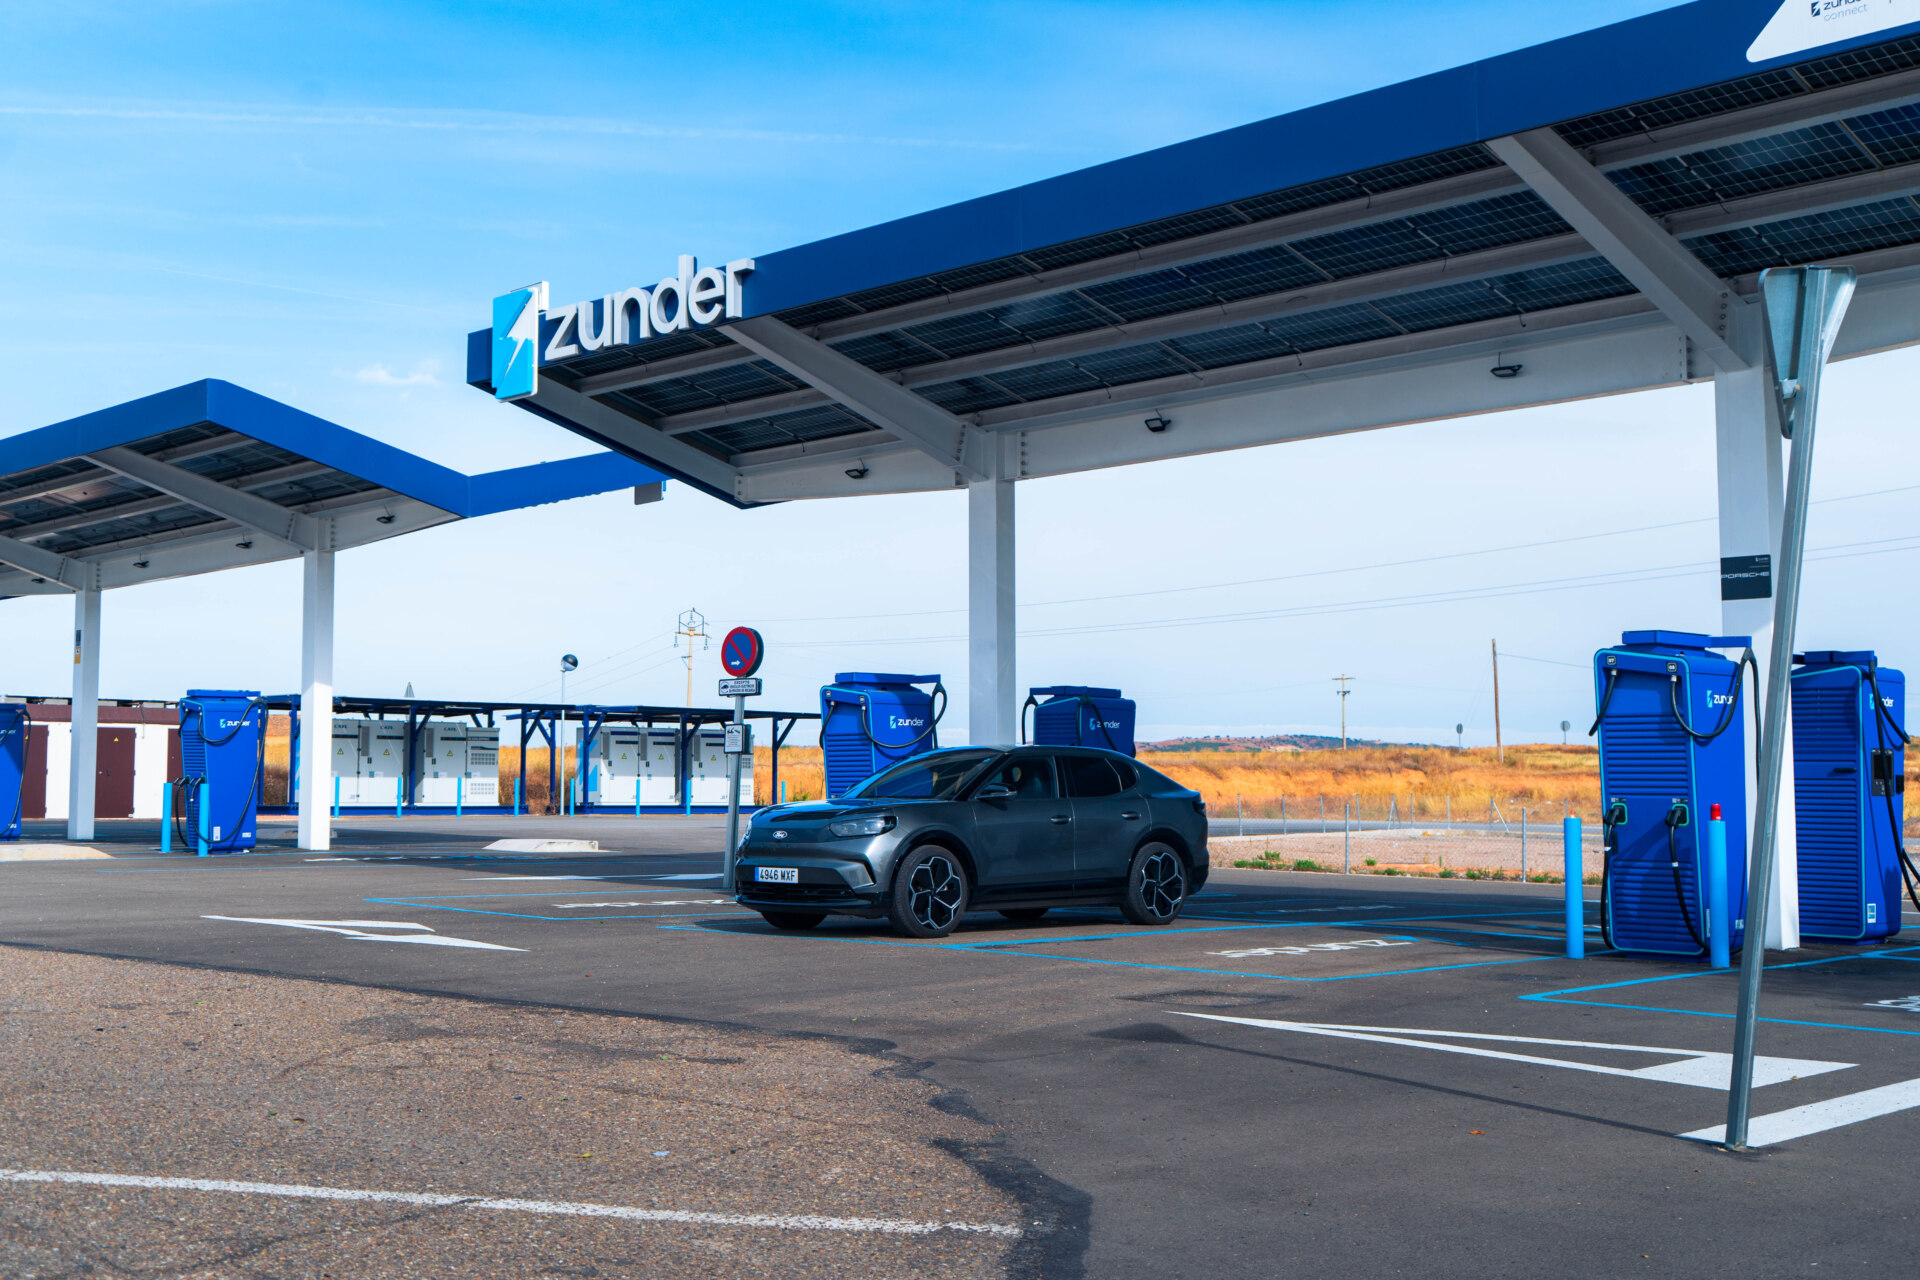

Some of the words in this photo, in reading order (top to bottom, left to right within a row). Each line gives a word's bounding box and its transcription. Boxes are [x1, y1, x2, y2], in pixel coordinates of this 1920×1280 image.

[1823, 3, 1867, 21] connect
[544, 254, 755, 361] zunder
[897, 717, 924, 726] zunder
[1096, 720, 1120, 729] znder
[760, 869, 779, 881] 4946
[780, 869, 796, 882] MXF
